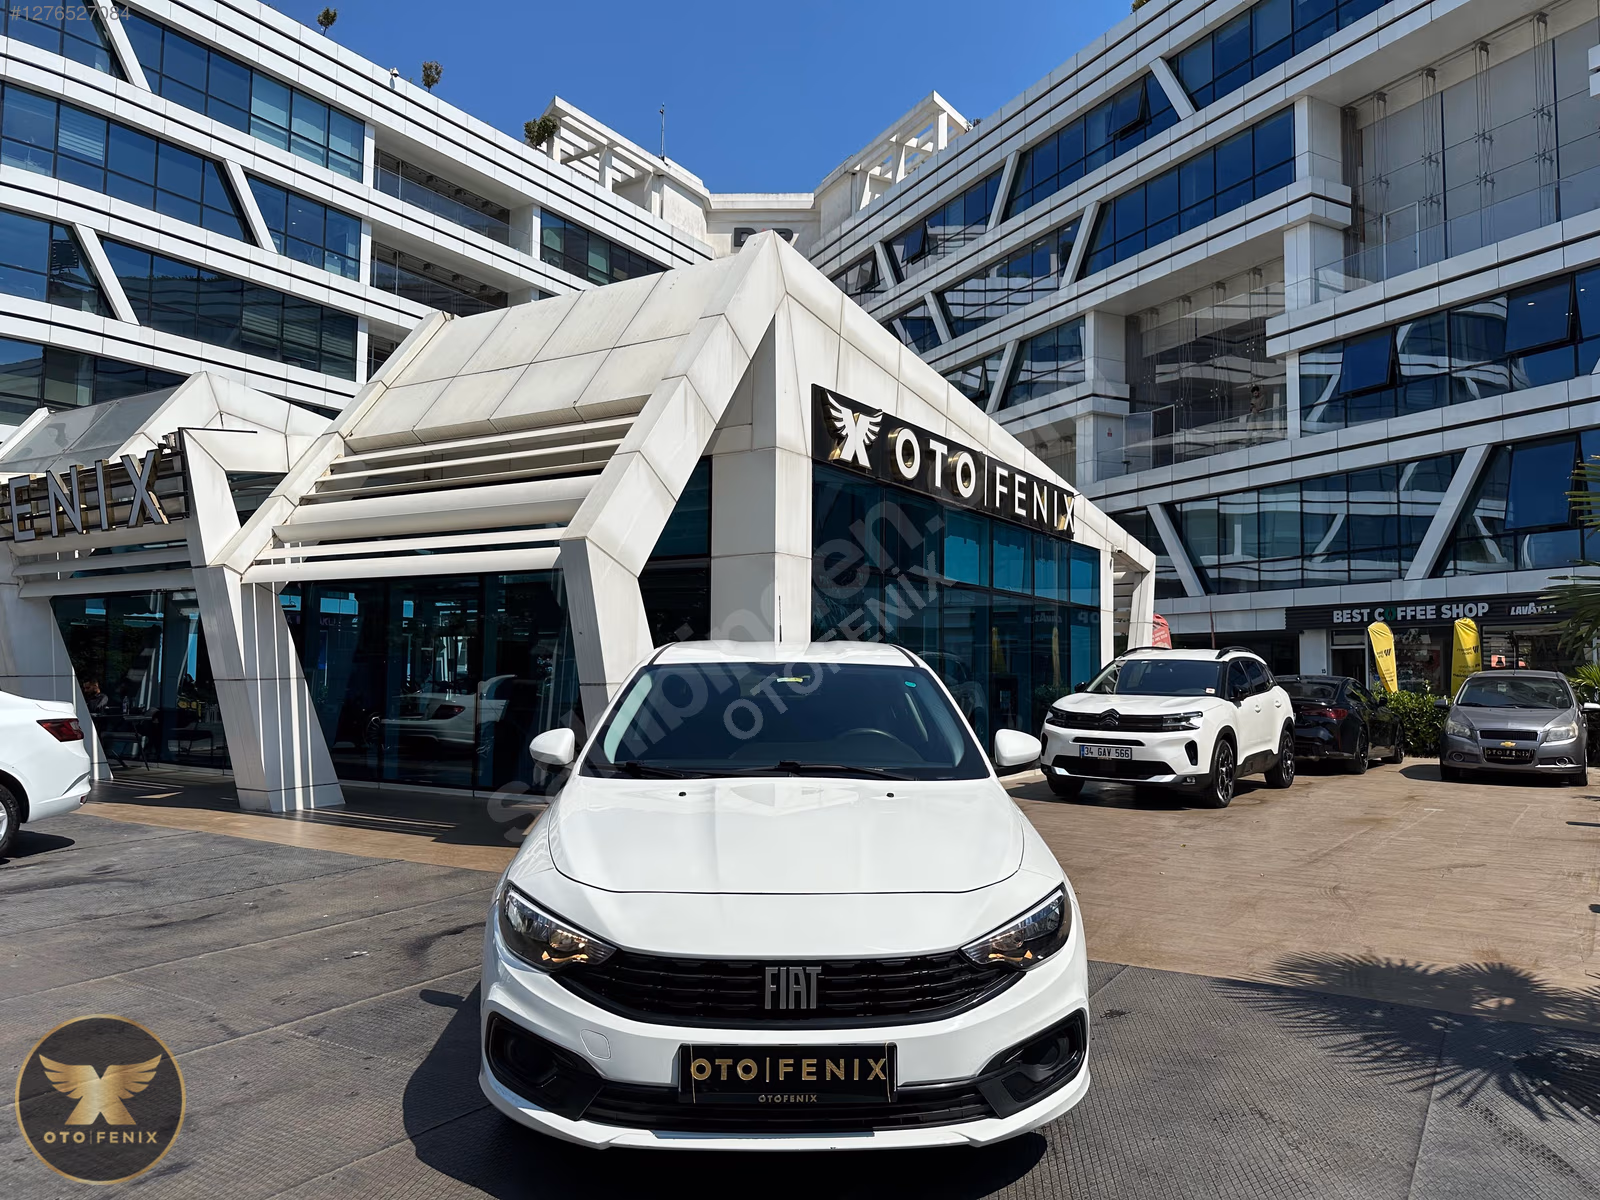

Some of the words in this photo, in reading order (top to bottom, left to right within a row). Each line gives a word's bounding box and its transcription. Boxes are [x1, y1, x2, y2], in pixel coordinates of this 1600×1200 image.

[1333, 609, 1370, 623] BEST
[1374, 606, 1437, 621] COFFEE
[1441, 602, 1489, 618] SHOP
[1510, 602, 1557, 616] LAVA
[1115, 748, 1130, 758] 566
[764, 966, 822, 1010] FIAT
[758, 1094, 818, 1103] OTOFENIX
